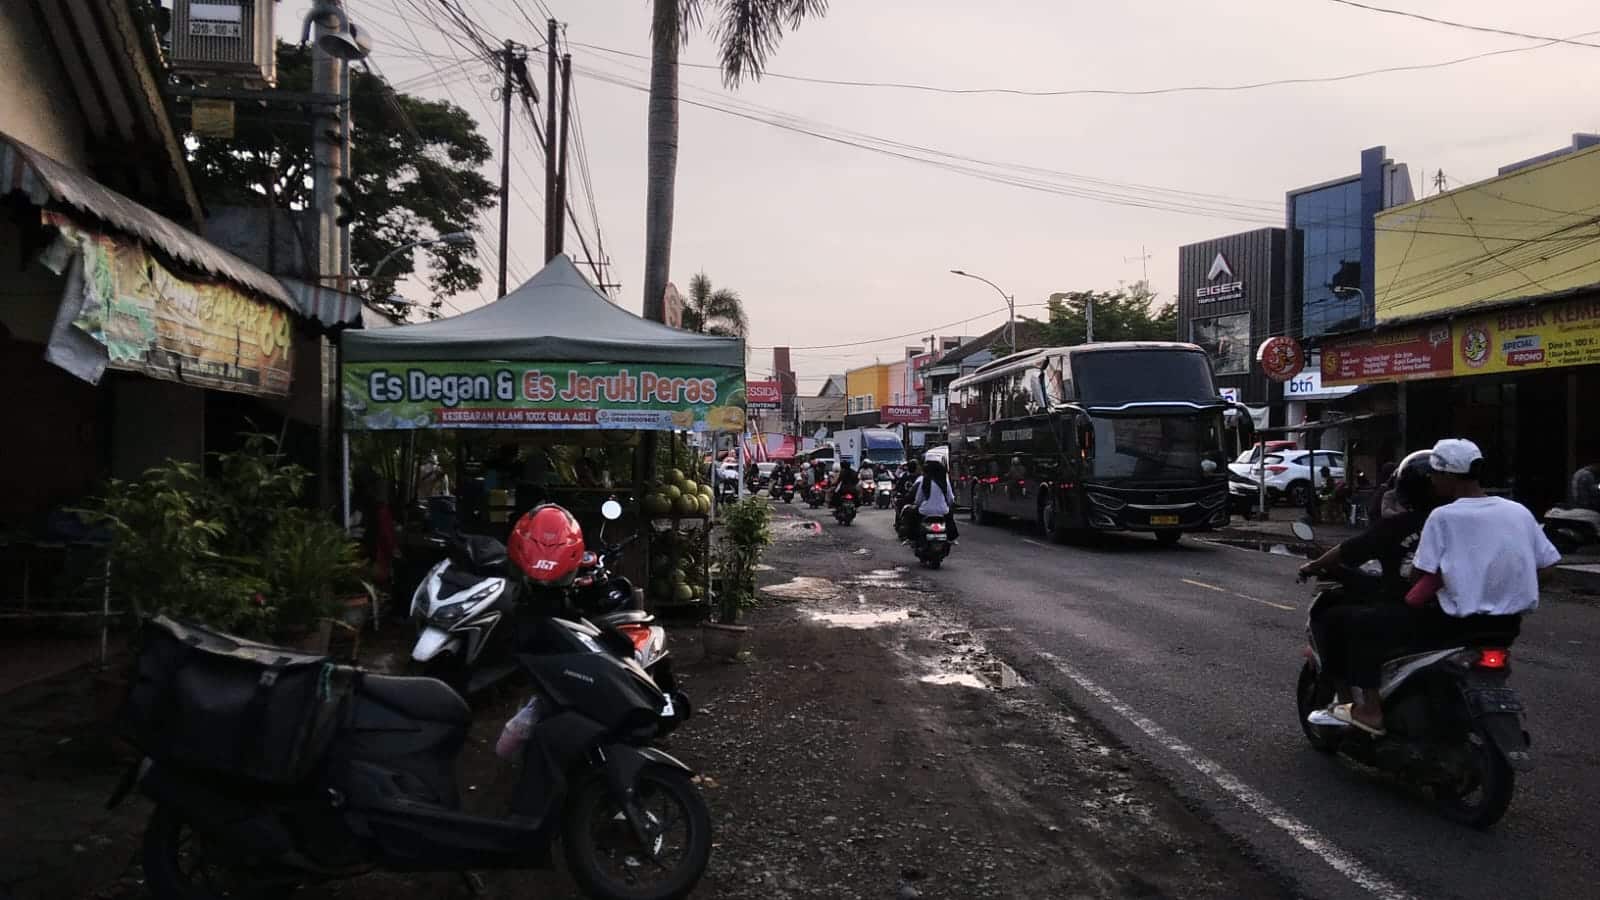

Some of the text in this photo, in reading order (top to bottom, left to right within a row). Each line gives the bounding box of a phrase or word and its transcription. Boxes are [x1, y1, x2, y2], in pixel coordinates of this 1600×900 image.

[1196, 281, 1243, 297] EIGER
[1498, 309, 1546, 331] BEBEK
[1503, 339, 1533, 351] SPECIAL
[1513, 352, 1543, 362] PROMO
[369, 369, 717, 407] Es Degan & Es Jeruk Peras
[1290, 376, 1313, 393] btn
[495, 411, 522, 421] ALAMI
[547, 411, 570, 421] GULA
[572, 411, 591, 421] ASLI
[531, 559, 560, 571] J&T
